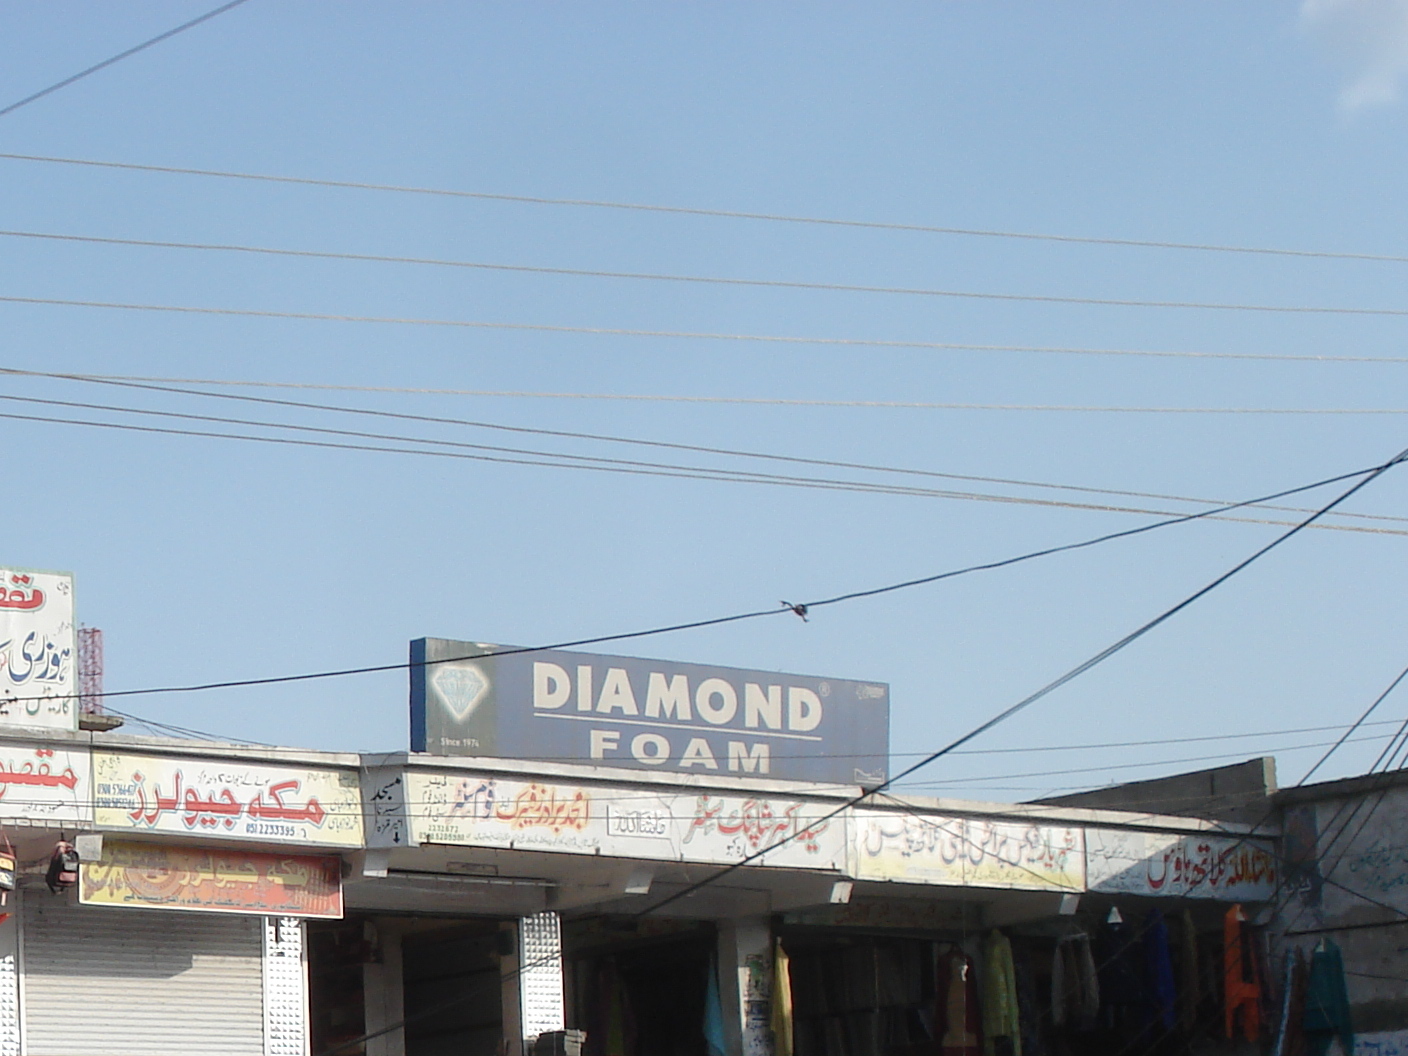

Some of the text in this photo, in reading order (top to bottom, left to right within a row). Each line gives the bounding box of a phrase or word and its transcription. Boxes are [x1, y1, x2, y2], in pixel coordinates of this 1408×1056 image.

[533, 661, 823, 732] DIAMOND
[589, 729, 771, 775] FOAM
[128, 768, 245, 828] جیولرز
[247, 780, 328, 826] مکہ
